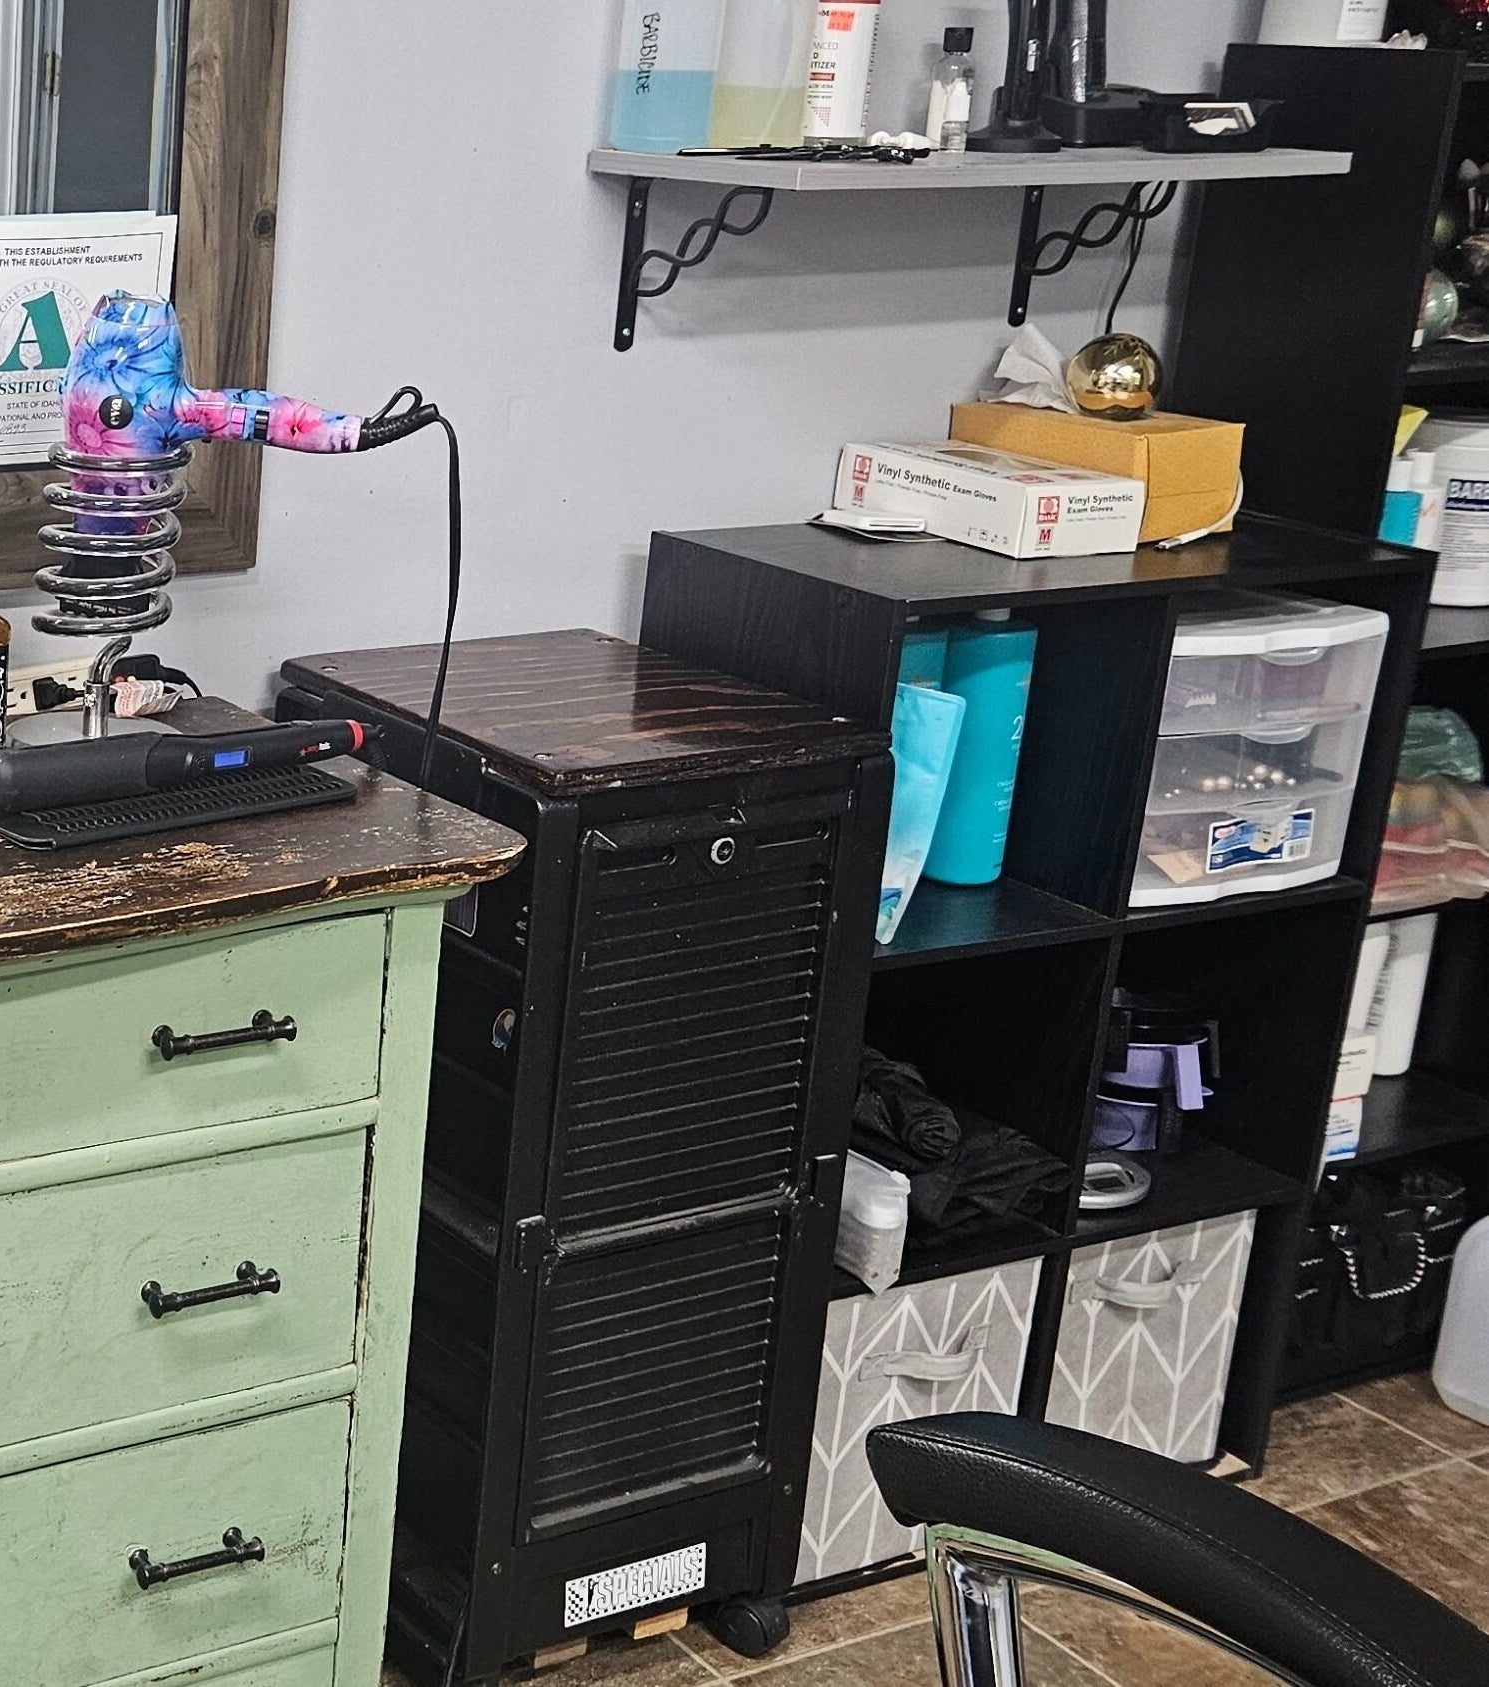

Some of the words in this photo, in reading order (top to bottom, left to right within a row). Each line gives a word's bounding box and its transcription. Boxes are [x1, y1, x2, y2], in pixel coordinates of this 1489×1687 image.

[636, 11, 660, 96] BARBICIDE
[810, 61, 836, 69] ITIZER
[4, 248, 24, 256] THIS
[25, 246, 91, 256] ESTABLISHMENT
[12, 258, 27, 267] THE
[29, 256, 83, 267] REGULATORY
[84, 253, 143, 265] REQUIREMENTS
[6, 402, 29, 410] STATE
[47, 411, 62, 420] PRO
[877, 462, 902, 479] Vinyl
[903, 470, 952, 491] Synthetic
[952, 485, 973, 496] Exam
[974, 490, 997, 502] Gloves
[1068, 495, 1090, 507] Vinyl
[1092, 493, 1134, 505] Synthetic
[1067, 506, 1088, 514] Exam
[1090, 505, 1114, 513] Gloves
[597, 1550, 700, 1611] SPECIALS
